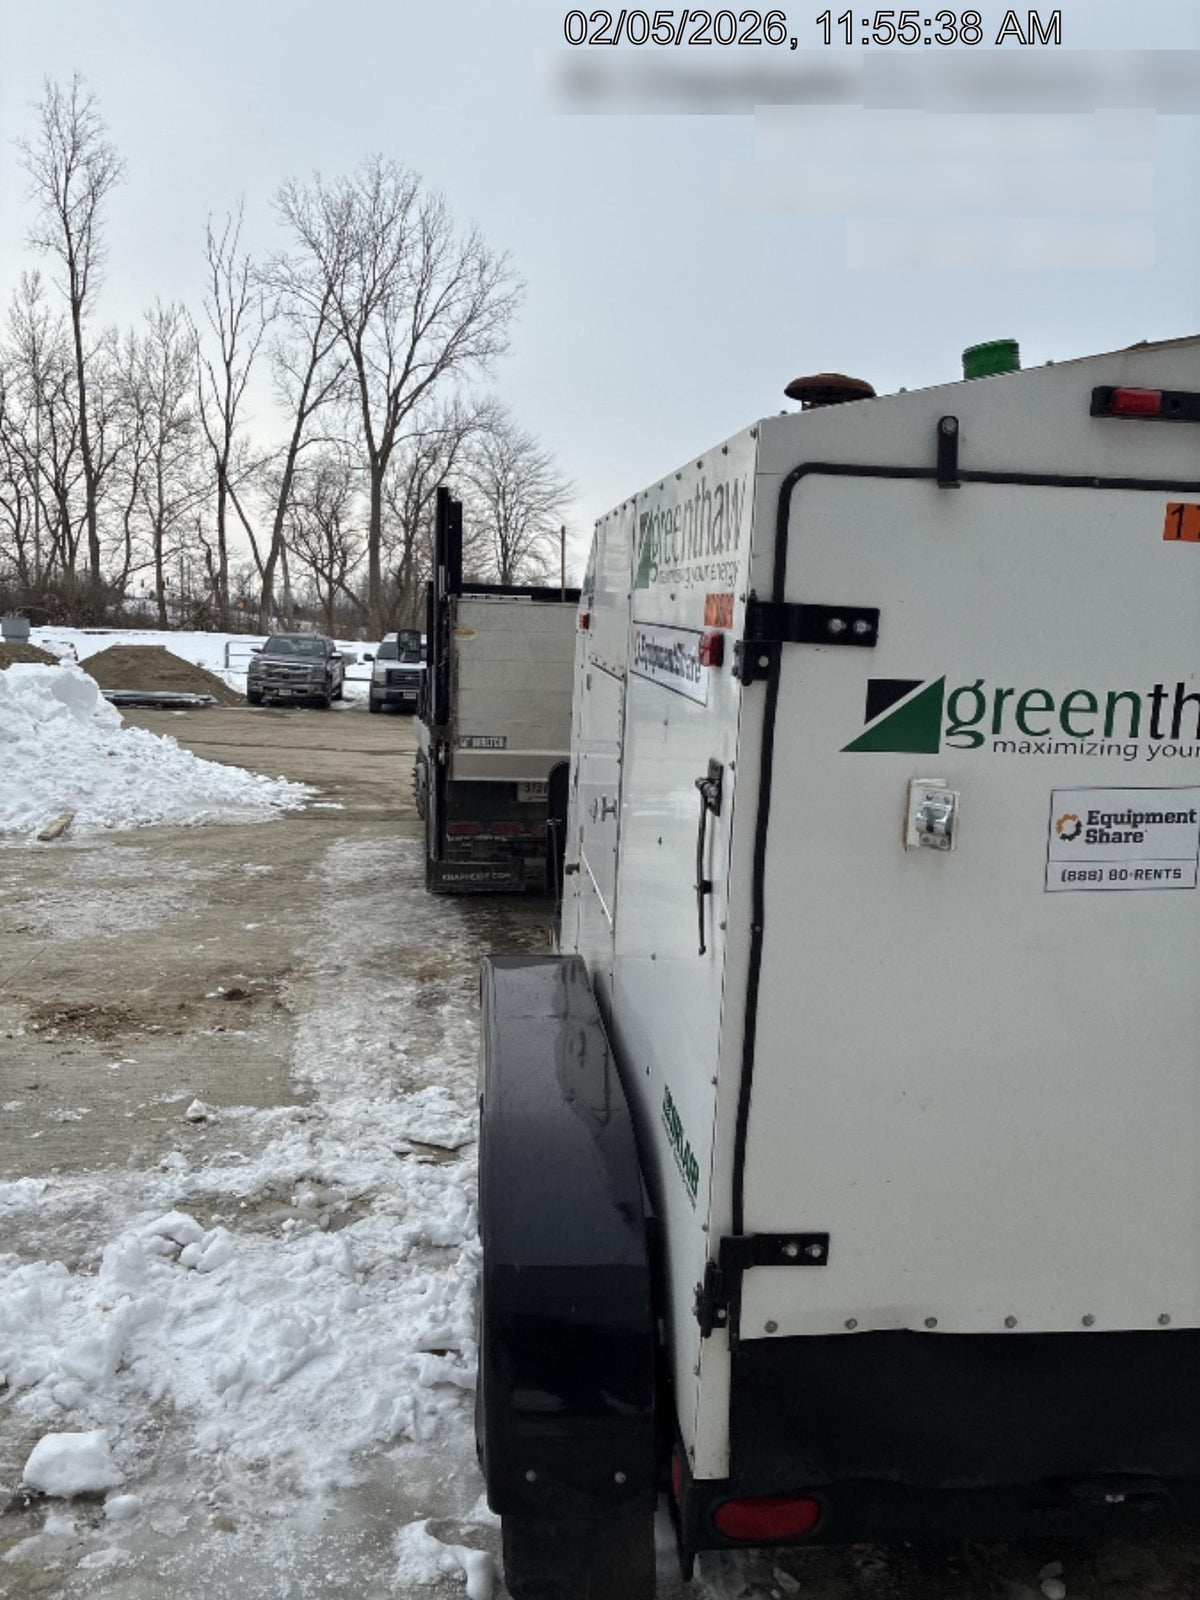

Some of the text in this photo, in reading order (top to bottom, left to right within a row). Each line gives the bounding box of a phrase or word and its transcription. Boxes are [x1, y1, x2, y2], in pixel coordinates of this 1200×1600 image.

[650, 473, 747, 584] greenthaw
[992, 738, 1139, 762] maximizing
[1086, 809, 1197, 829] Equipment
[1084, 829, 1145, 844] Share
[1061, 868, 1103, 882] (888)
